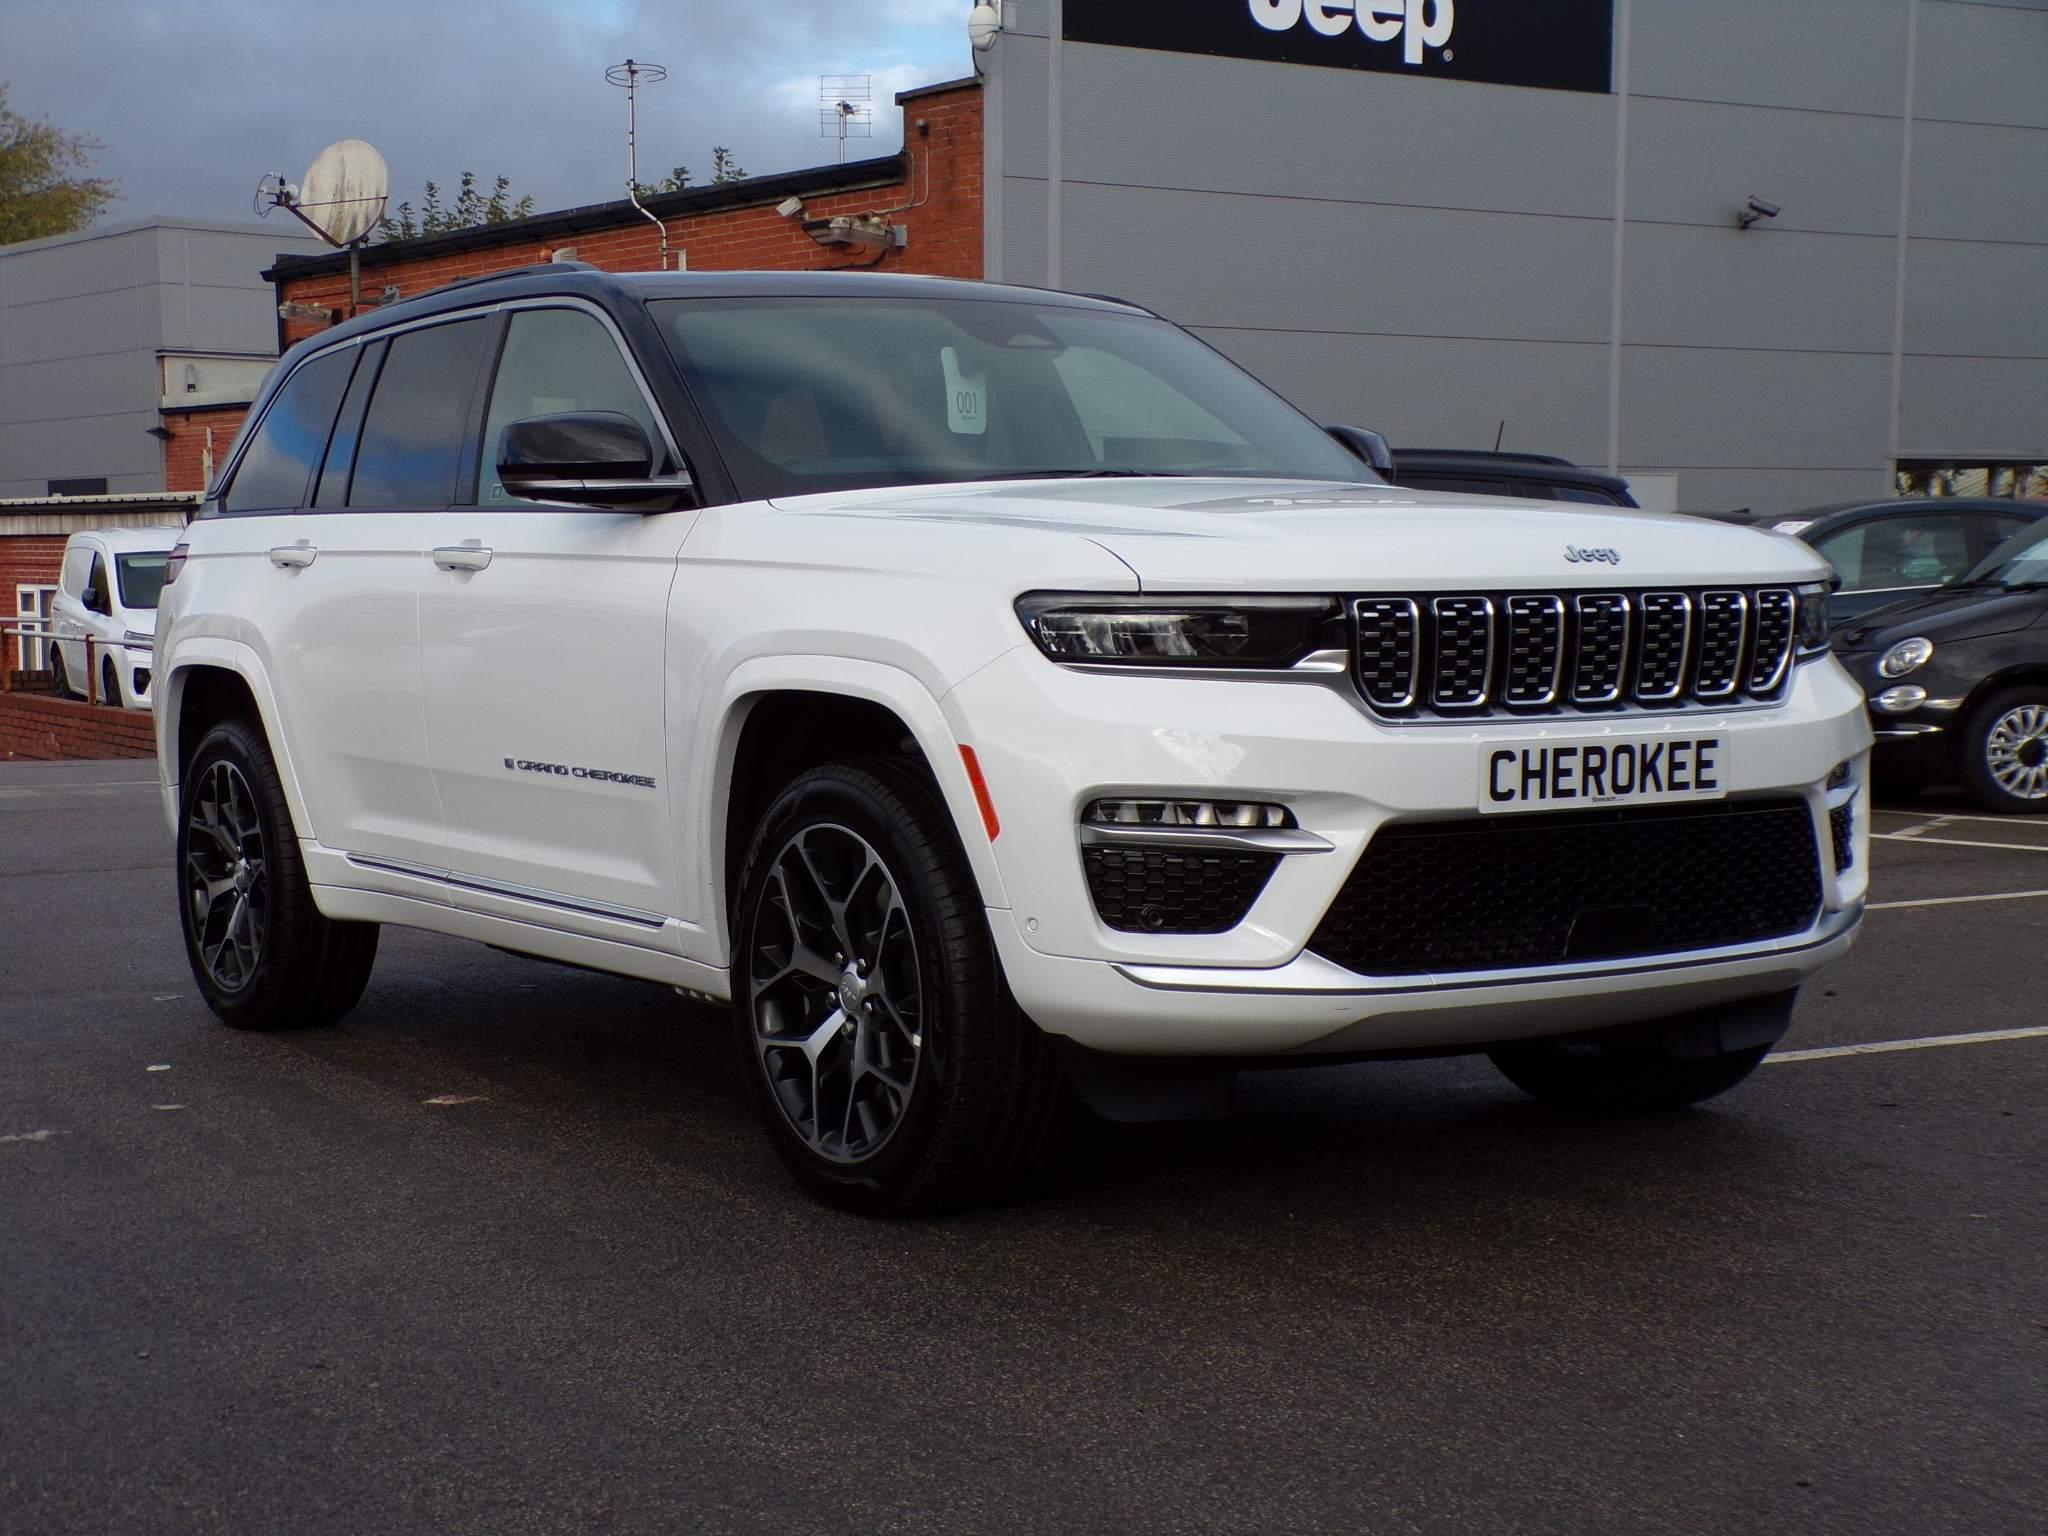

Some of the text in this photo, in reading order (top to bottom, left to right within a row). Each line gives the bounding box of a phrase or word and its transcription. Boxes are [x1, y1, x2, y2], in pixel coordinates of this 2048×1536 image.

[956, 391, 977, 415] 001
[1563, 544, 1621, 566] Jeep
[516, 759, 657, 789] GRAND CHEROKEE
[1489, 738, 1720, 803] CHEROKEE
